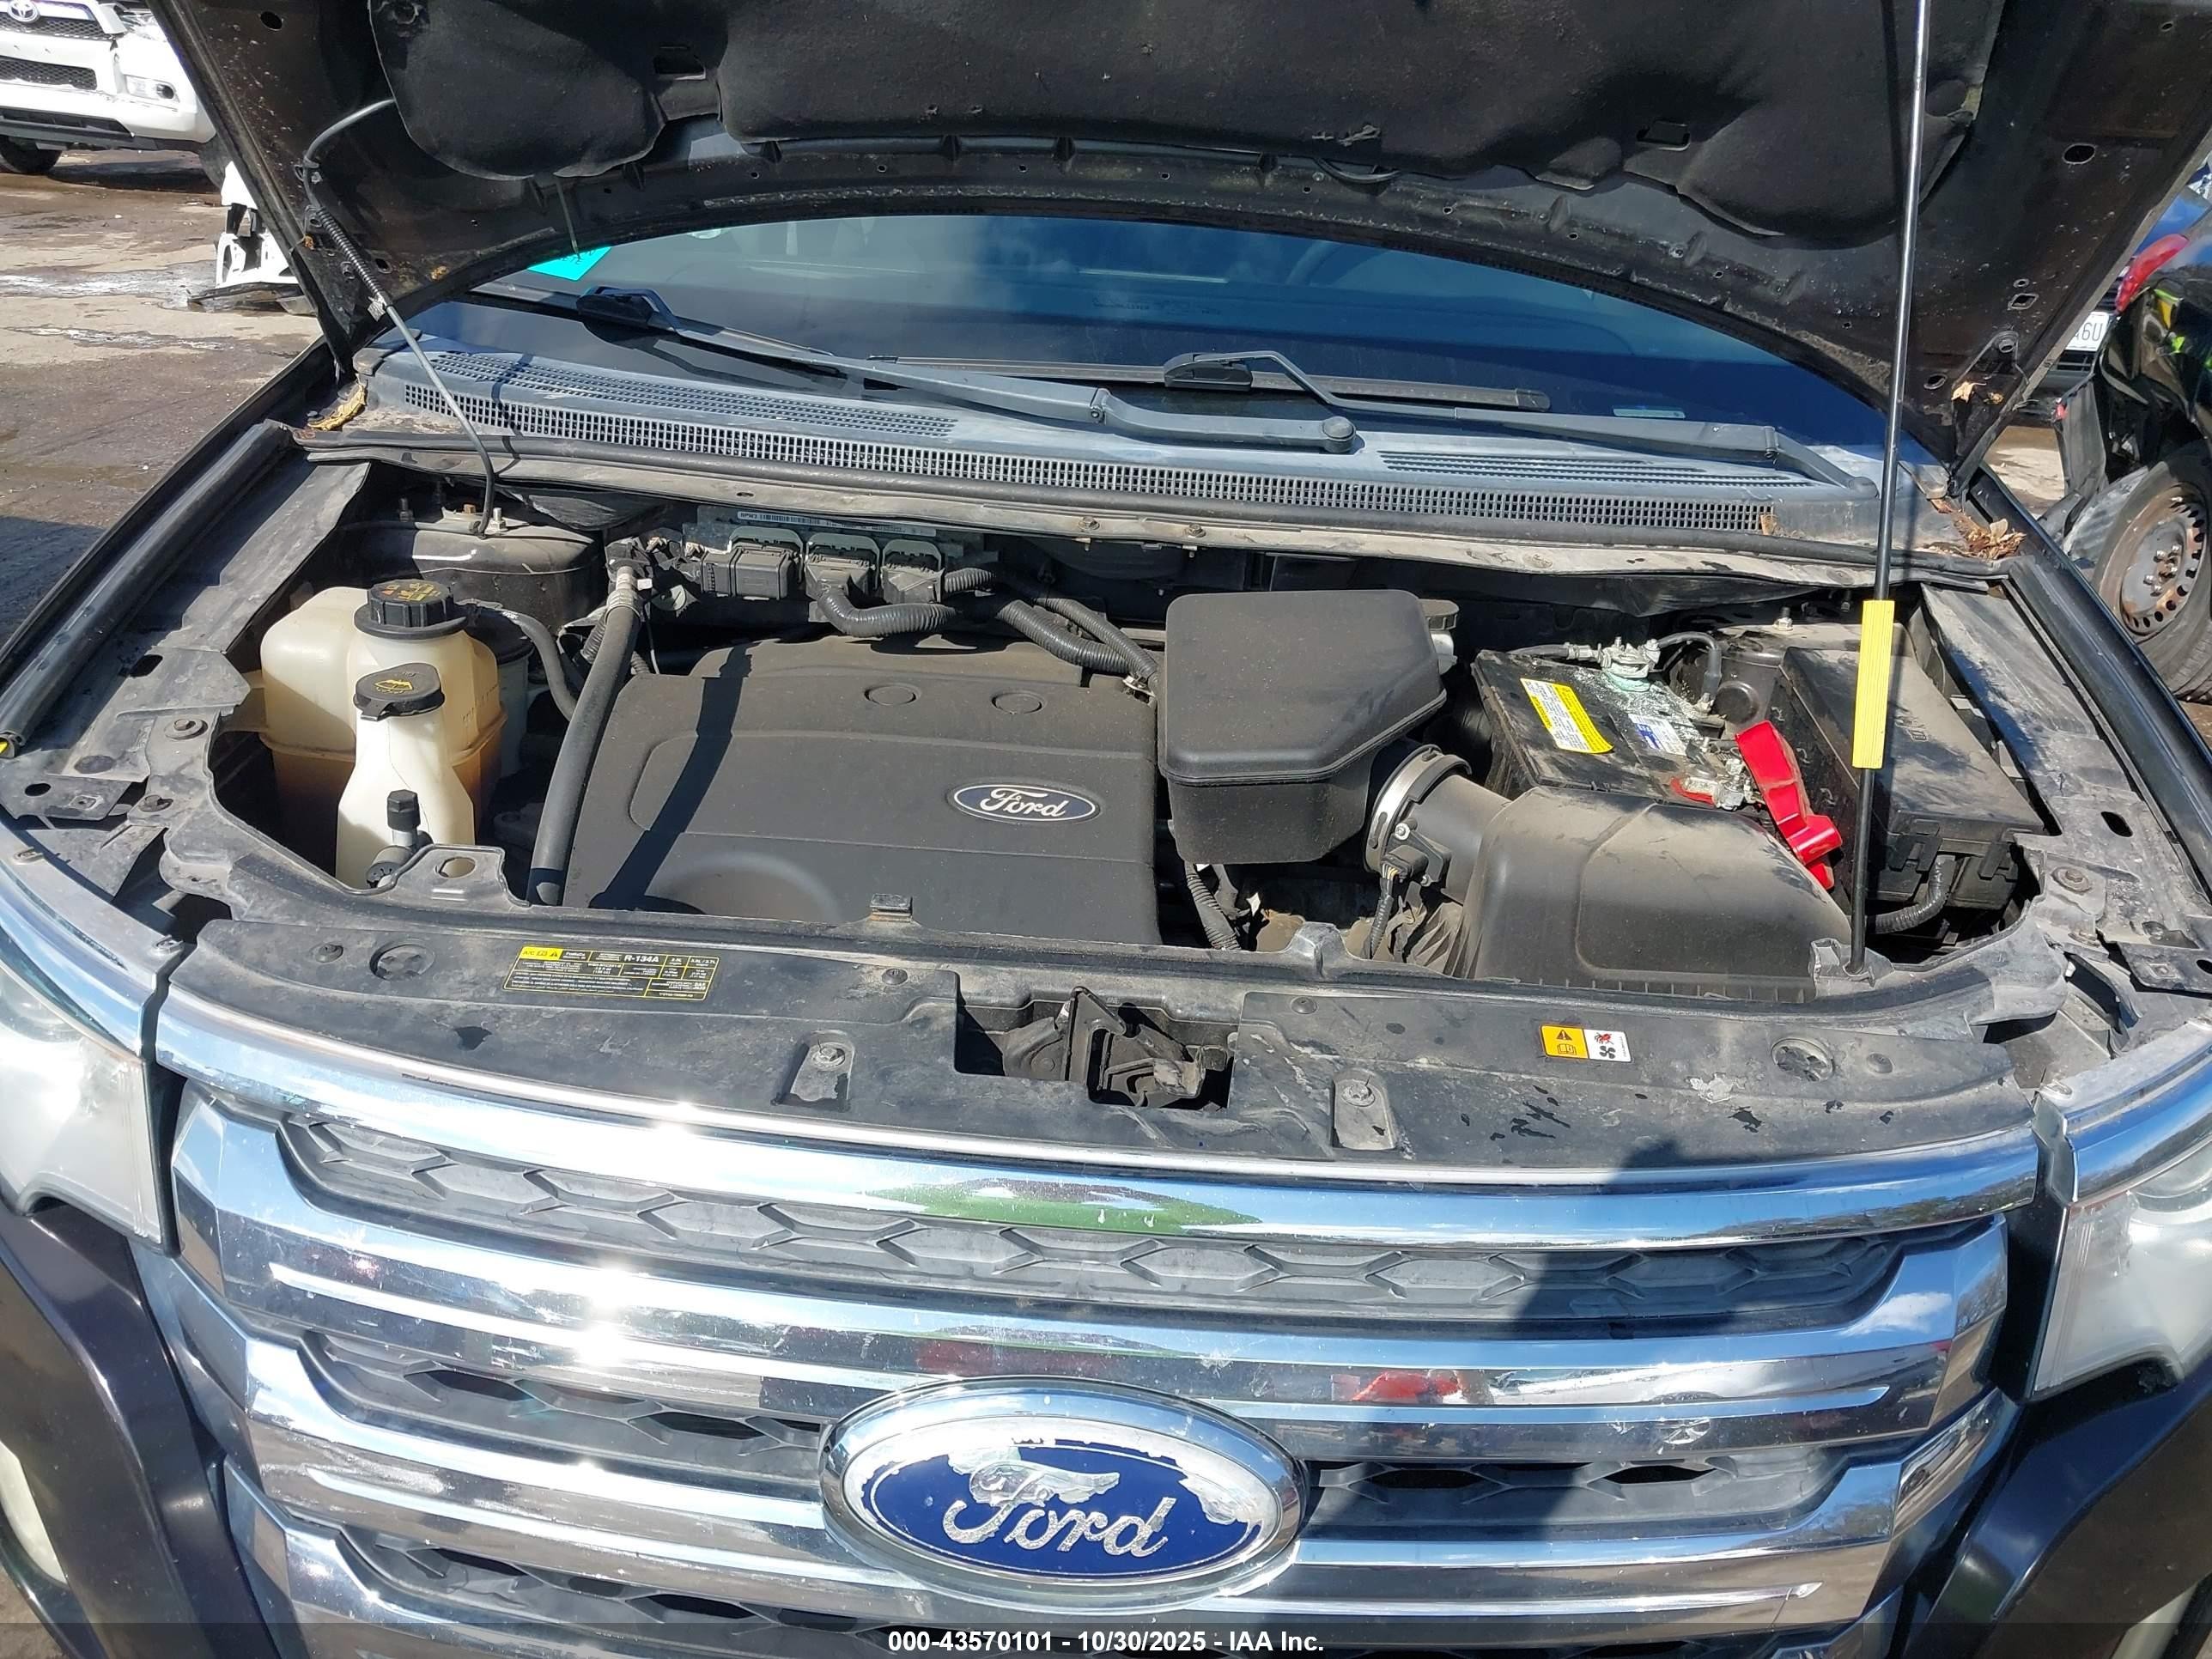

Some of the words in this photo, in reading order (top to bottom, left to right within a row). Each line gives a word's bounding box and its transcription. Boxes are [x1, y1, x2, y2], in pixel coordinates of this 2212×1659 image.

[2075, 322, 2104, 342] 6U
[980, 787, 1070, 817] Ford
[623, 954, 659, 963] R-134A
[943, 1461, 1176, 1558] Ford
